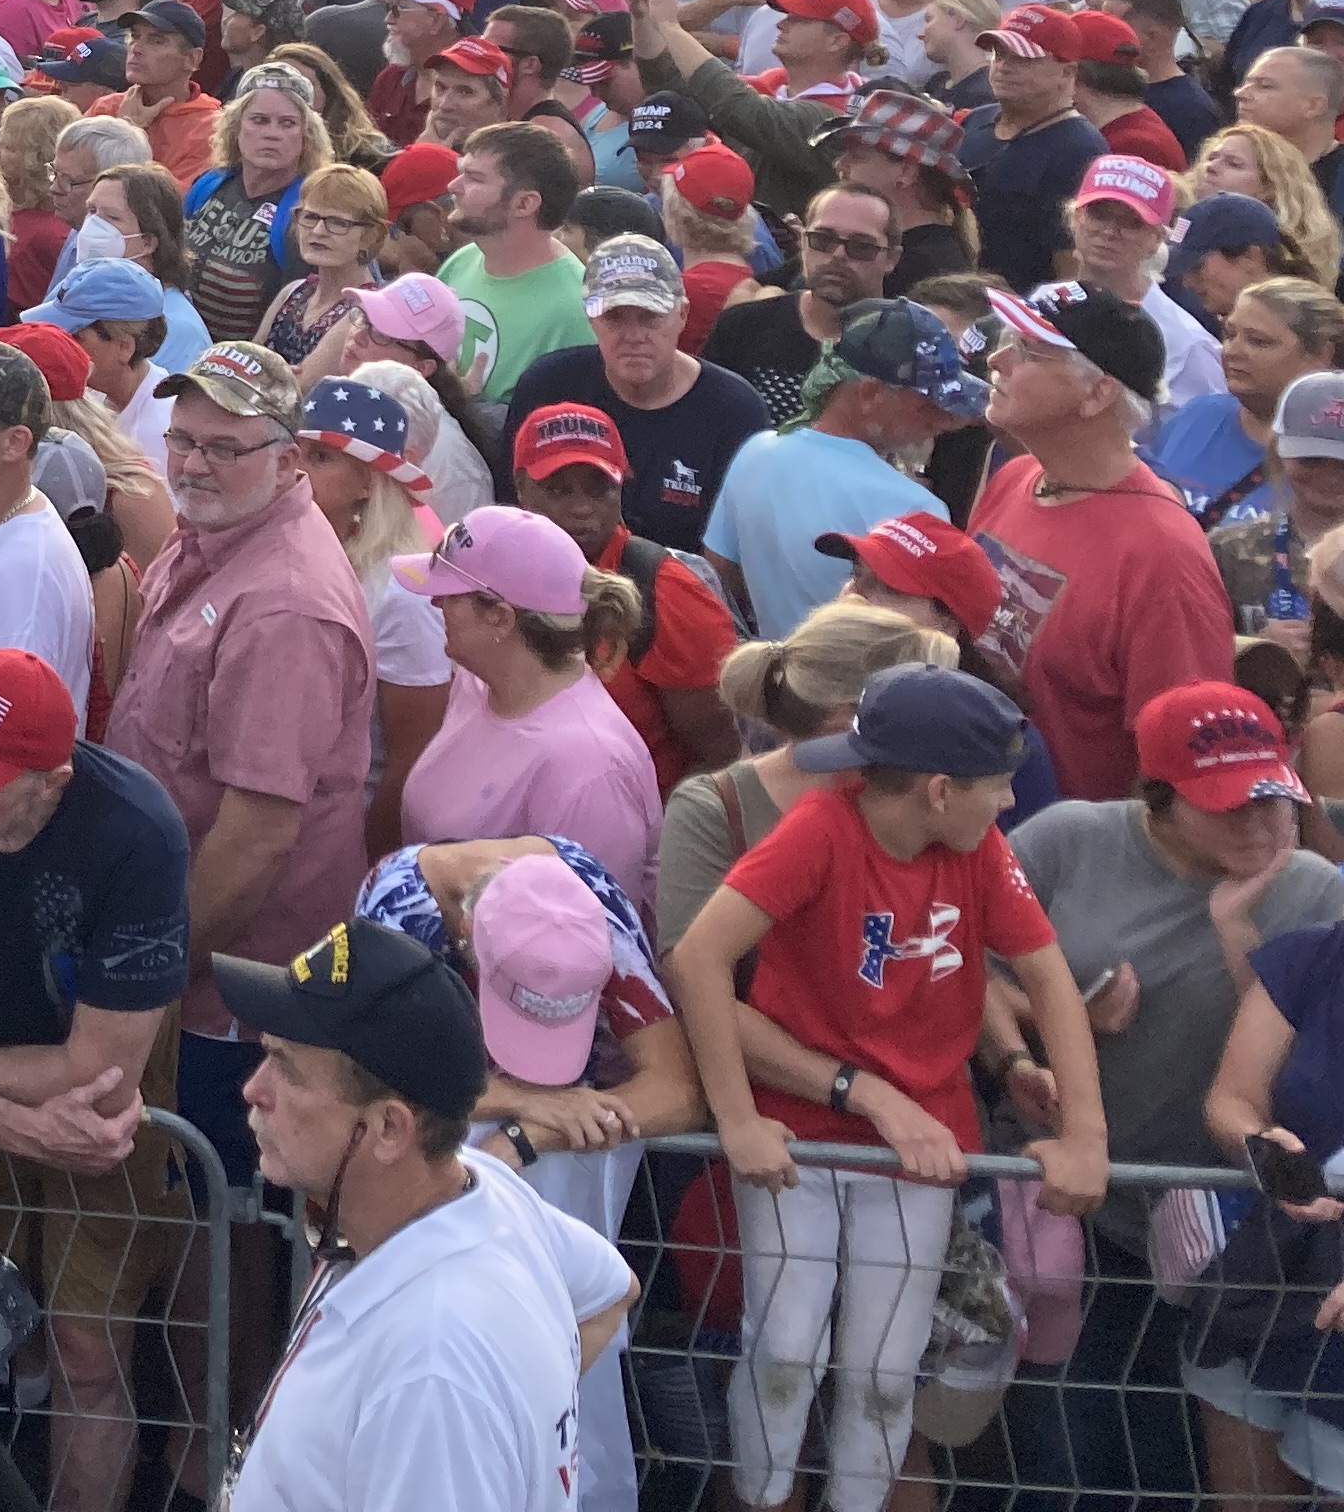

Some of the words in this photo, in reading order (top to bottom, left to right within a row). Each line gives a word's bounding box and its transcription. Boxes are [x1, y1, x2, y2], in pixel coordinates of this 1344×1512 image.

[633, 106, 671, 118] TRUMP
[188, 229, 213, 248] MY
[210, 244, 268, 265] SAVIOR
[600, 254, 658, 271] Trump
[536, 418, 610, 438] TRUMP
[663, 477, 703, 495] TRUMP
